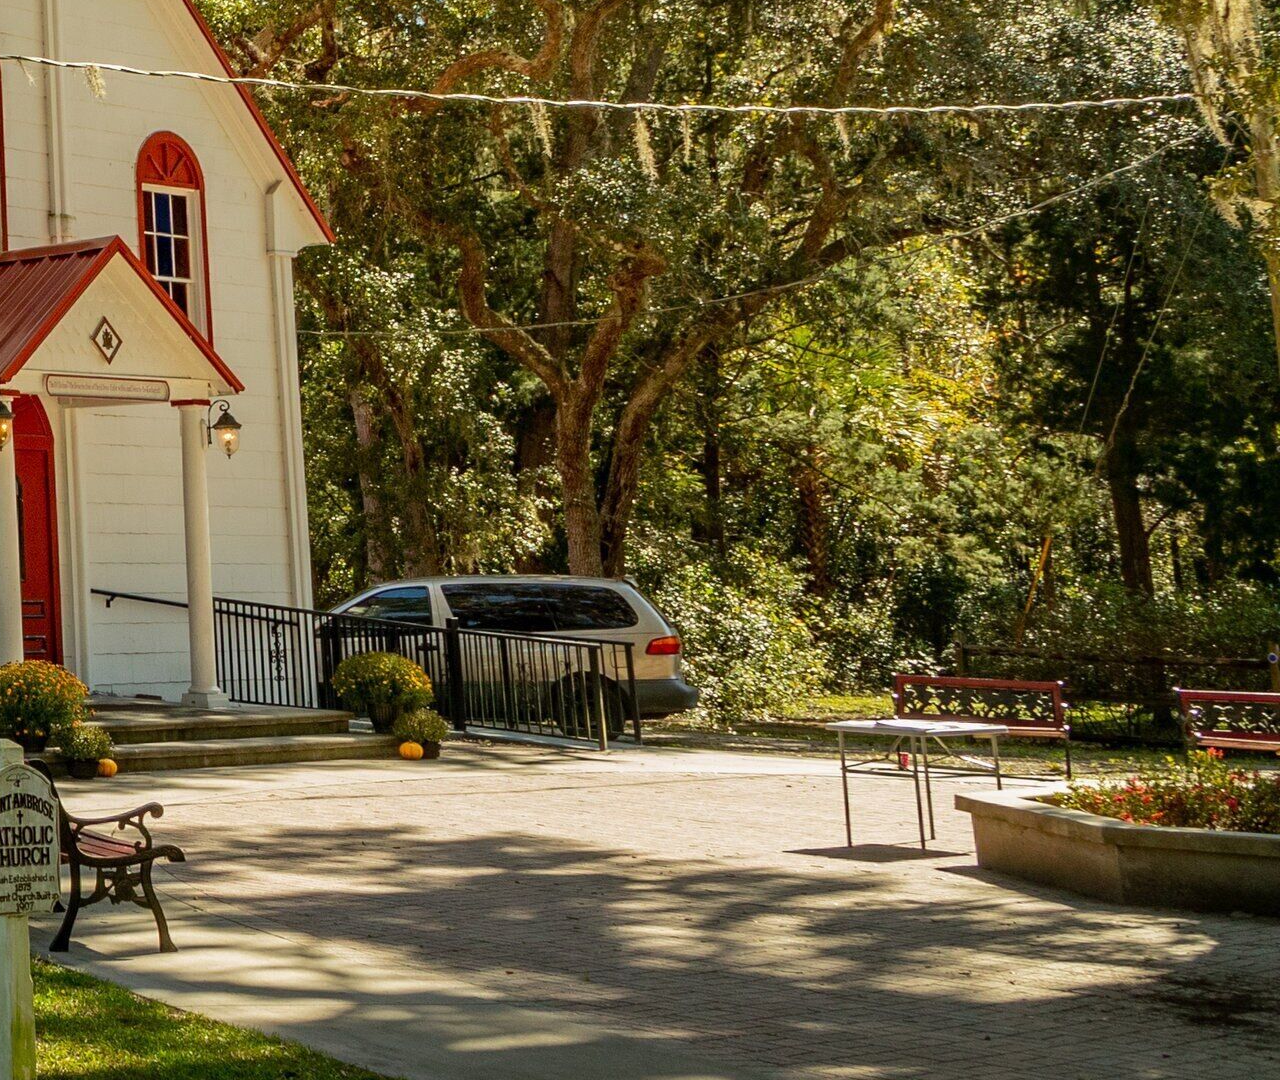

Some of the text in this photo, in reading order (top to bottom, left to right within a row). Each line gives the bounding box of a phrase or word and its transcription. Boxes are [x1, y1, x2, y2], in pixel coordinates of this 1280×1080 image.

[13, 792, 54, 822] AMBROSE
[8, 873, 48, 884] Established
[48, 874, 55, 882] in
[11, 892, 35, 902] Church
[35, 890, 51, 900] Built
[16, 901, 35, 912] 1907
